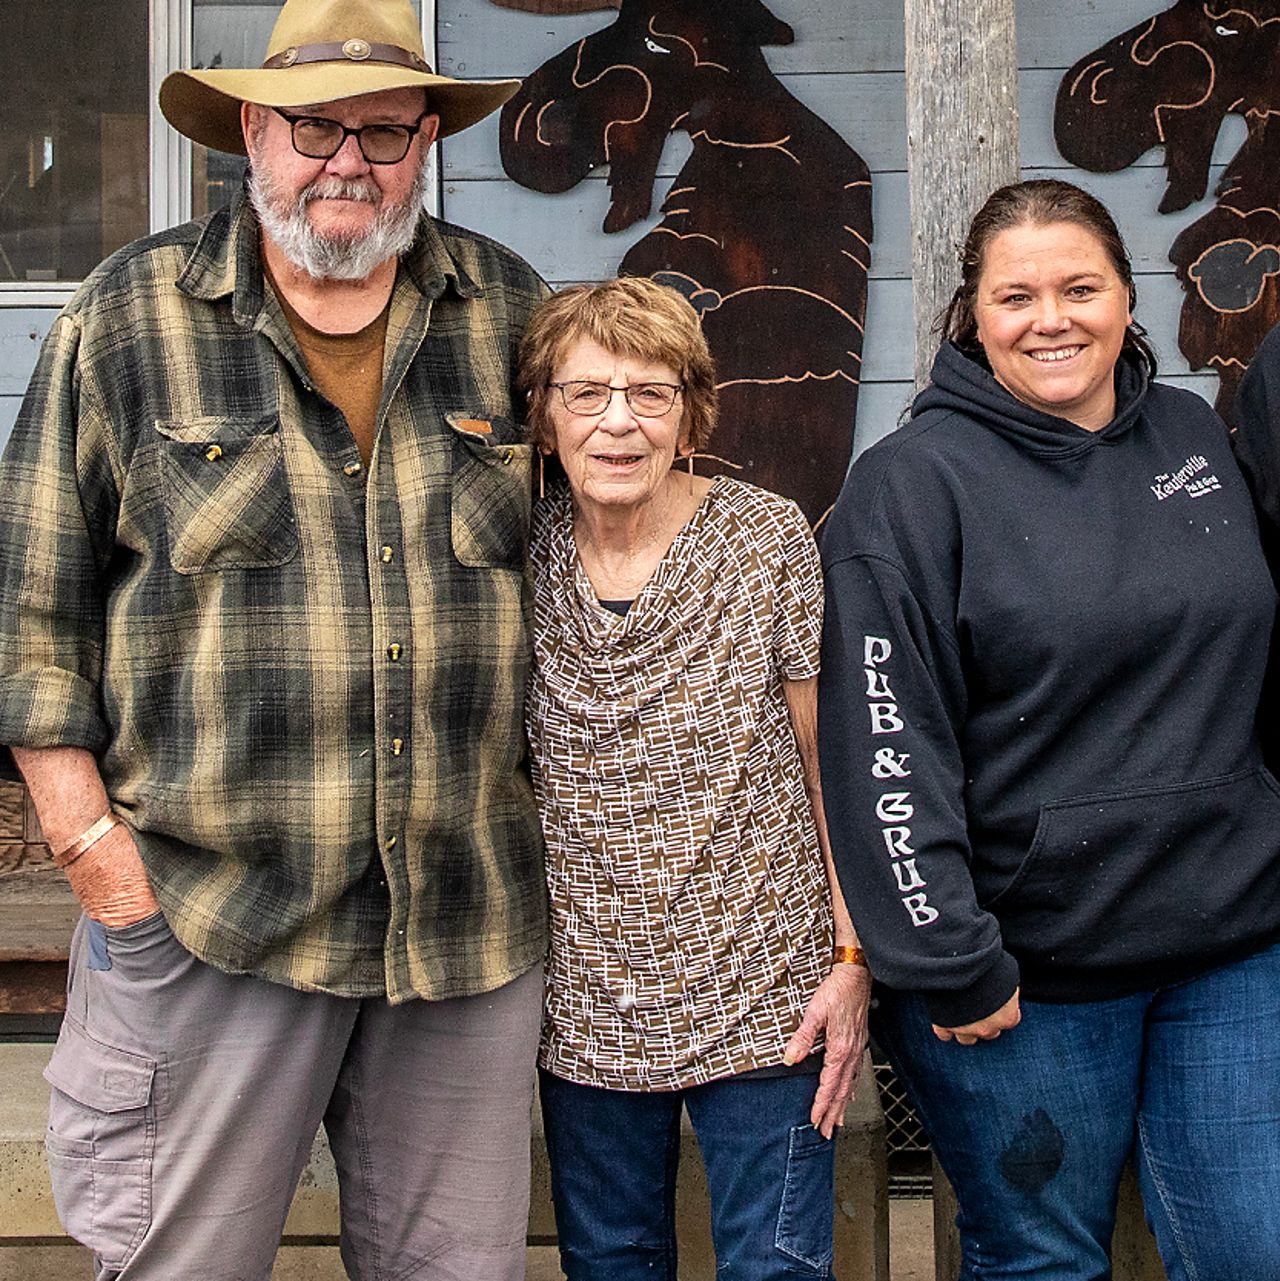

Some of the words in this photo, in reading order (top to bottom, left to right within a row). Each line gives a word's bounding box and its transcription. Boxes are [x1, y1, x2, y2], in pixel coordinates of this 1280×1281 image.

[863, 635, 904, 735] PUB
[872, 748, 911, 778] &
[876, 791, 939, 927] GRUB
